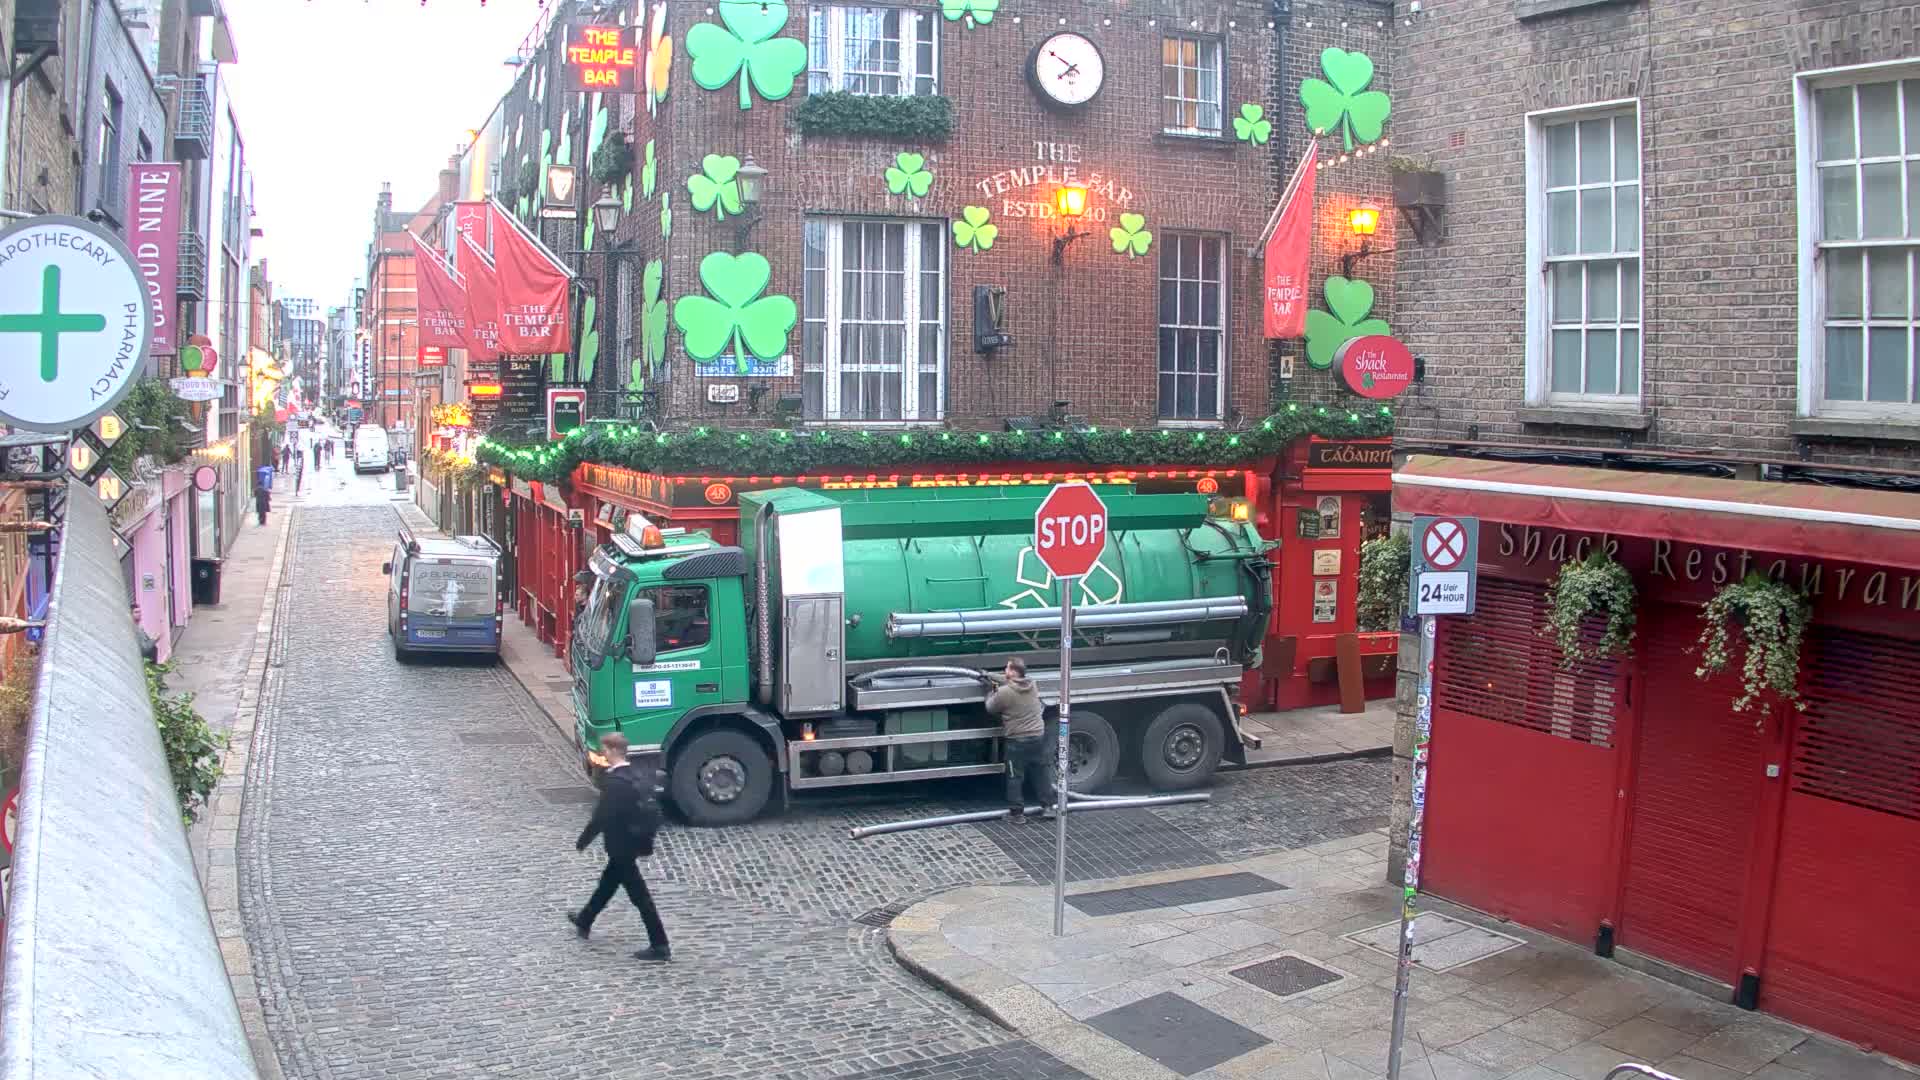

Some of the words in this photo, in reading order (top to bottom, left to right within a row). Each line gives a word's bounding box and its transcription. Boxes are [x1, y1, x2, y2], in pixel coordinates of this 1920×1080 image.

[584, 28, 620, 46] THE
[567, 46, 635, 65] TEMPLE
[583, 69, 619, 86] BAR
[1033, 140, 1082, 163] THE
[976, 164, 1080, 199] TEMPLE
[1087, 172, 1134, 210] BAR
[138, 171, 171, 232] NINE
[1002, 199, 1057, 220] ESTD.
[0, 232, 116, 267] APOTHECARY
[1276, 275, 1292, 286] THE
[1267, 286, 1303, 300] TEMPLE
[521, 304, 546, 314] THE
[424, 317, 465, 328] TEMPLE
[503, 313, 564, 326] TEMPLE
[434, 327, 456, 336] BAR
[519, 326, 552, 337] BAR
[90, 302, 137, 401] PHARMACY
[510, 362, 531, 371] BAR
[697, 365, 727, 374] TEMPLE
[752, 365, 778, 374] SOUTH
[1355, 350, 1388, 373] Shack
[1371, 371, 1409, 381] Restaurant
[635, 476, 652, 499] BAR
[710, 487, 726, 499] 48
[1040, 514, 1105, 549] STOP
[1499, 523, 1619, 565] Shack
[1421, 583, 1441, 602] 24
[1443, 593, 1465, 602] HOUR
